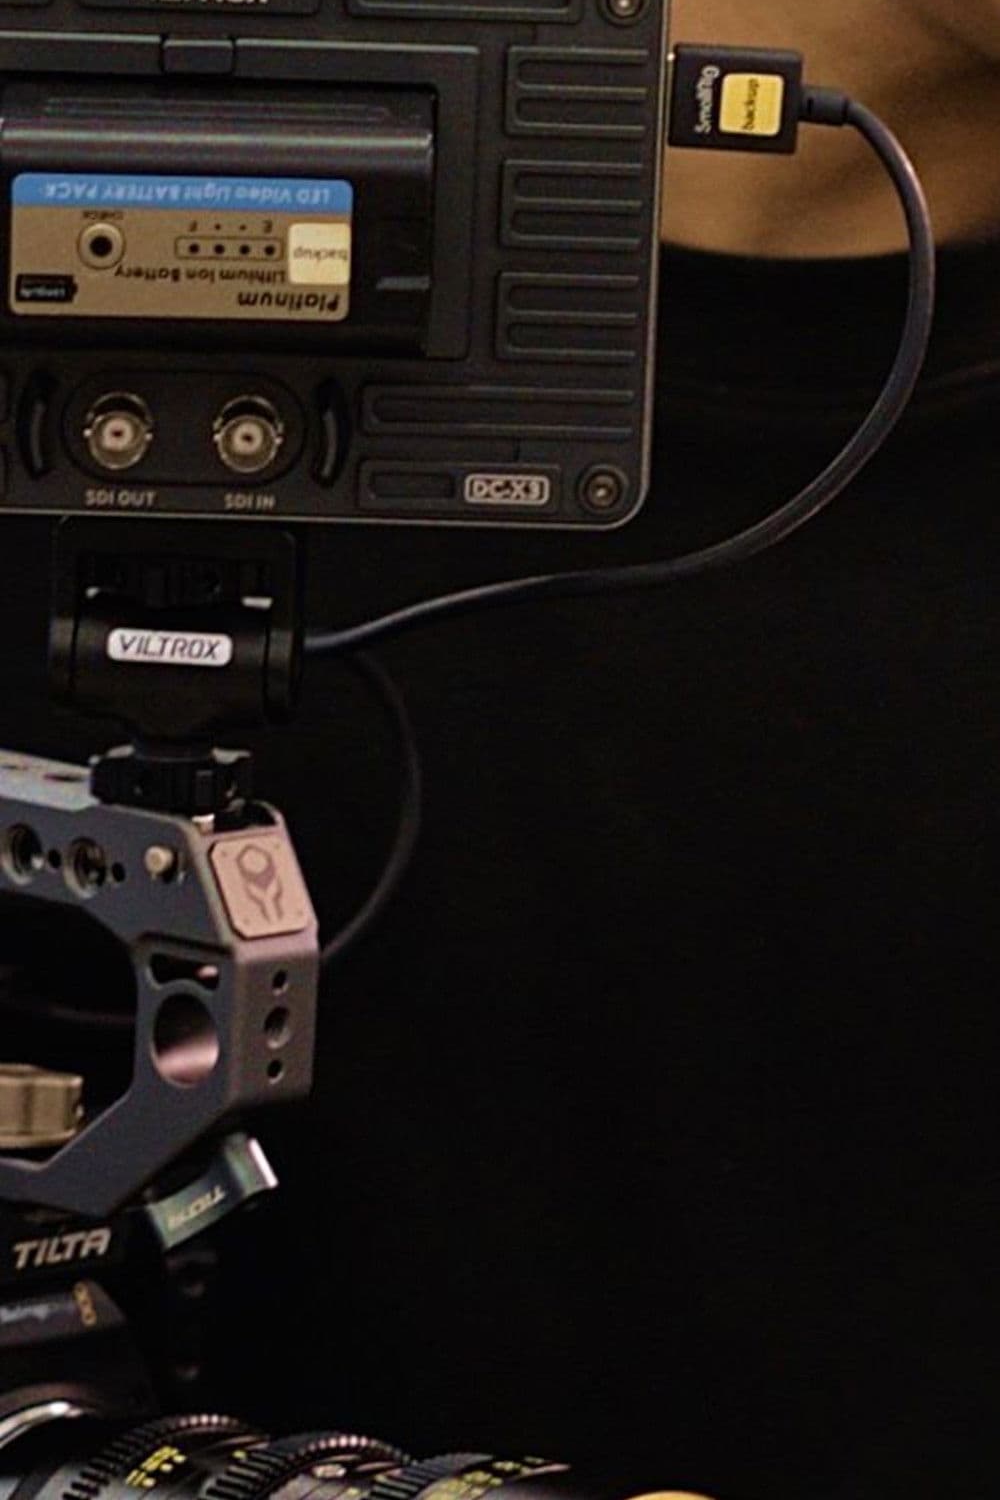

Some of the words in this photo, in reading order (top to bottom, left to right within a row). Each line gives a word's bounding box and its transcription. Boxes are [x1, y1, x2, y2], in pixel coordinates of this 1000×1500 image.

[45, 182, 98, 199] PACK
[103, 183, 180, 201] BATTERY
[185, 182, 231, 203] Light
[234, 185, 292, 203] Video
[114, 265, 181, 282] Battery
[218, 268, 287, 284] Lithium
[237, 291, 341, 312] Platinum
[85, 489, 115, 507] SDI
[117, 489, 157, 508] OUT
[224, 492, 253, 510] SDI
[255, 493, 276, 511] IN
[118, 633, 222, 661] VILTROX
[12, 1227, 112, 1271] TILTA
